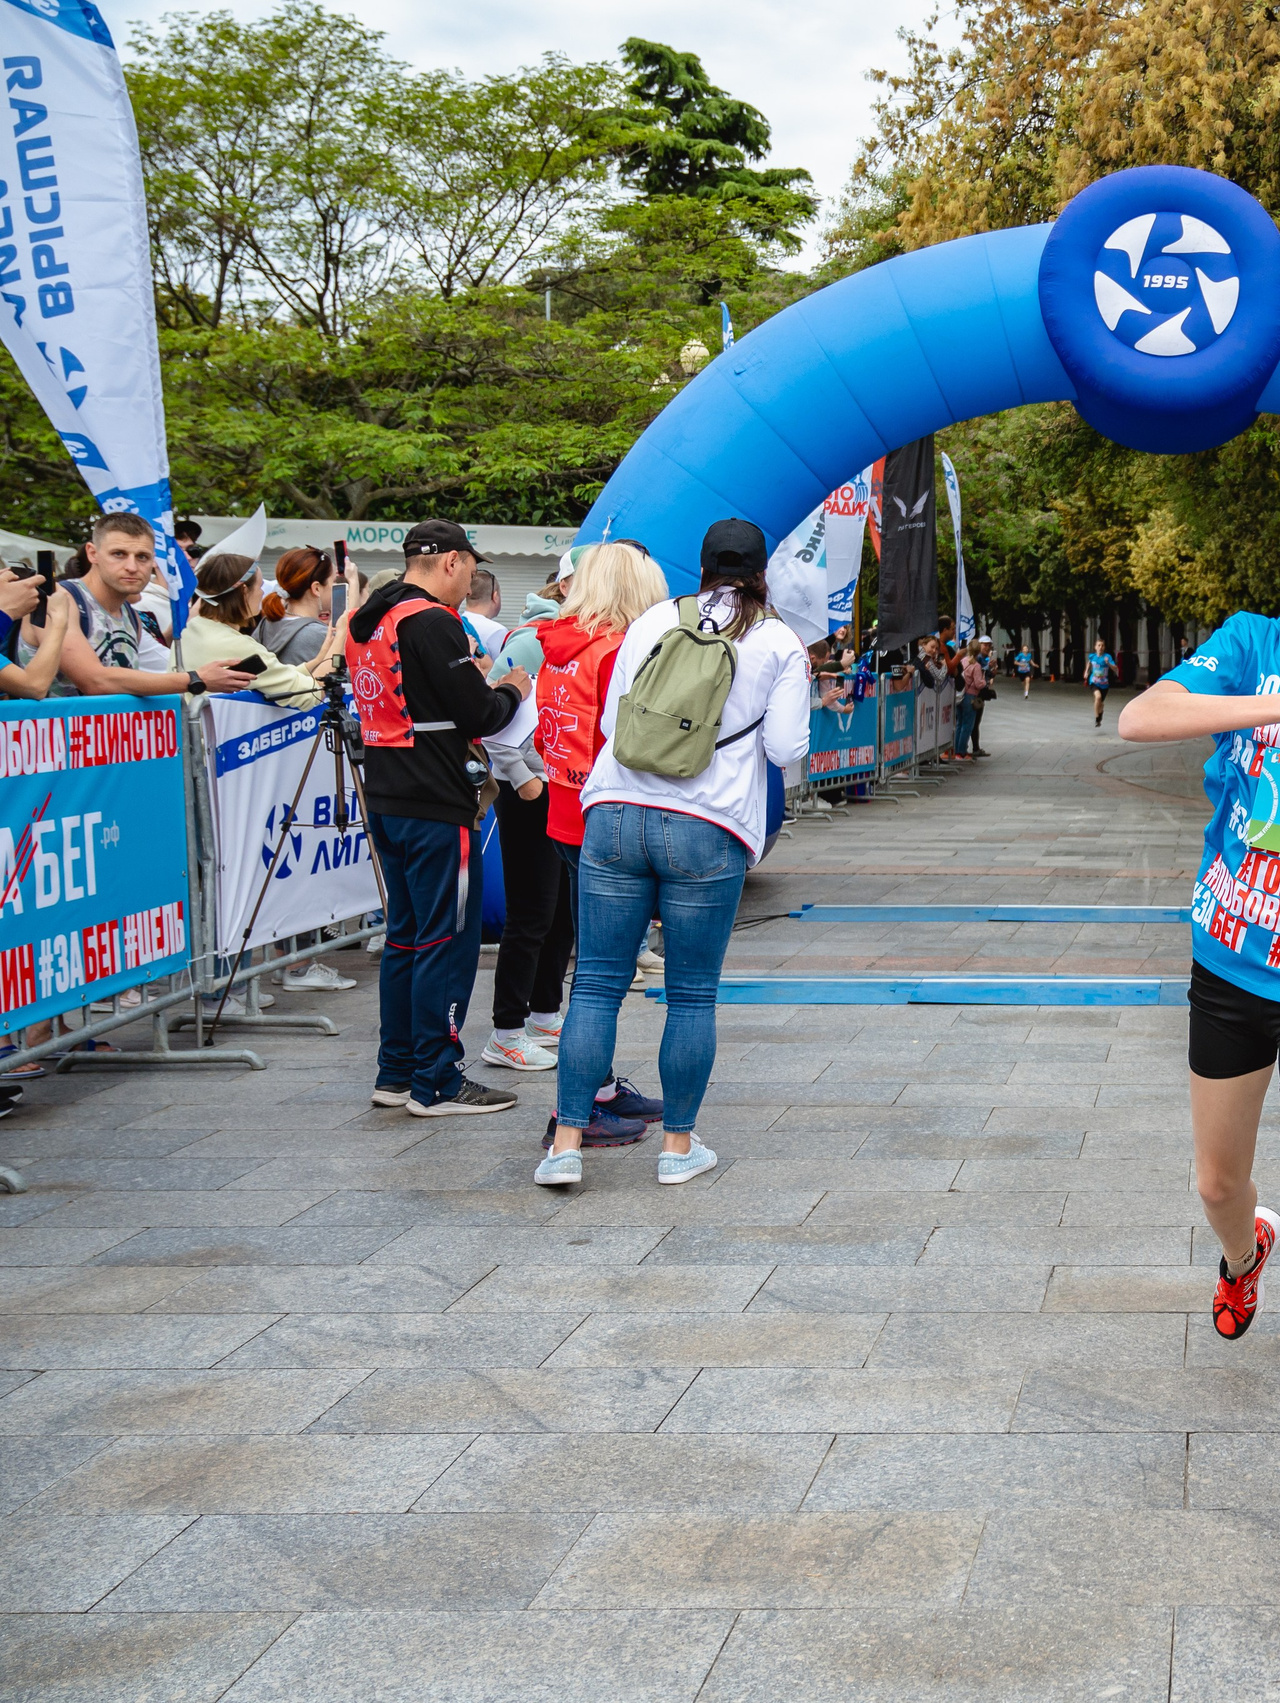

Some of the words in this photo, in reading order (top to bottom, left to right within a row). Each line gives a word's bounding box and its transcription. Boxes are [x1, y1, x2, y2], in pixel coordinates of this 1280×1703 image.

[1143, 274, 1189, 289] 1995
[68, 709, 178, 769] #ЕДИНСТВО
[238, 716, 316, 760] ЗАБЕГ.РФ
[39, 919, 121, 999] #ЗАБЕГ
[123, 901, 186, 970] #ЦЕЛЬ
